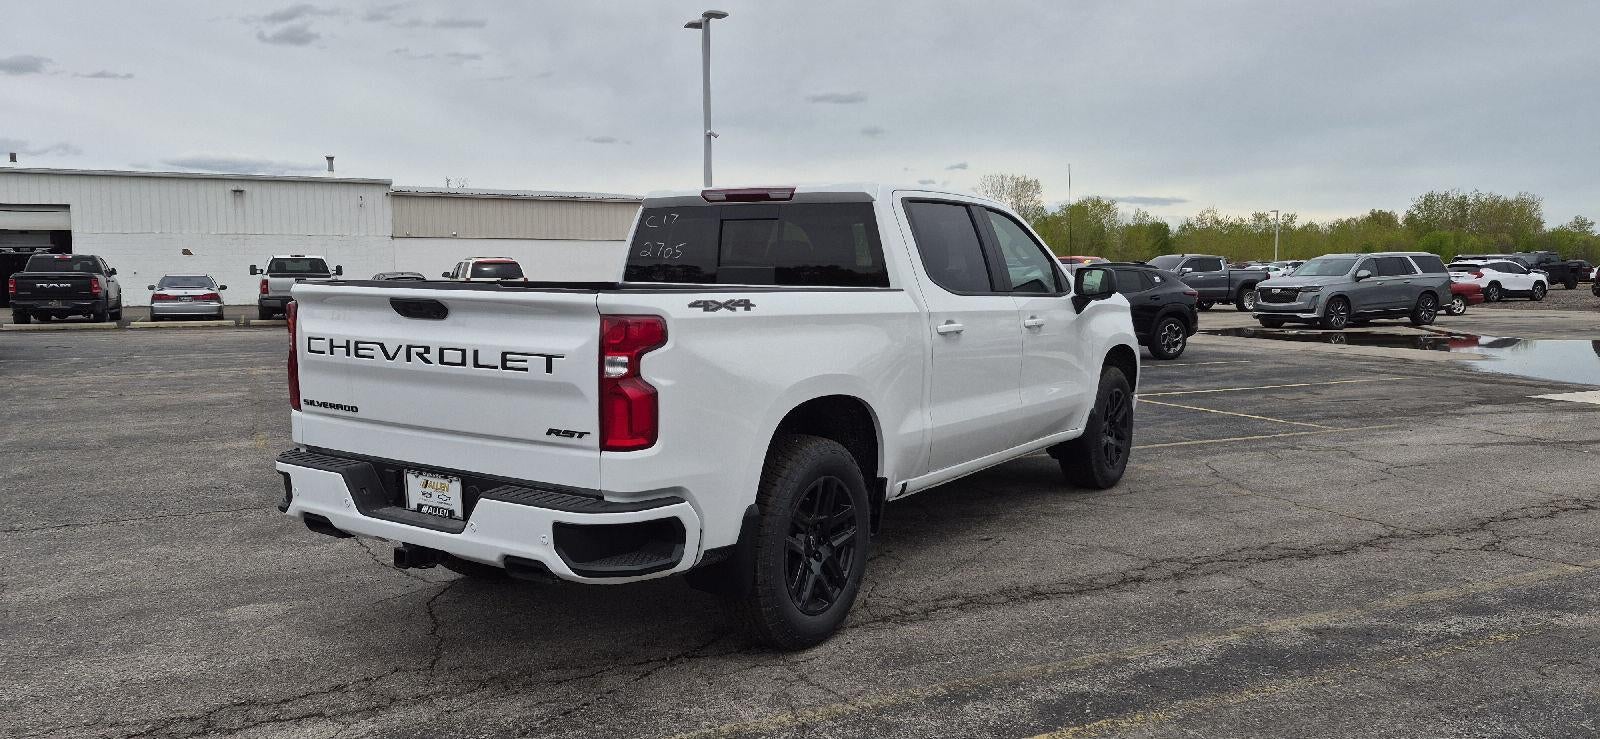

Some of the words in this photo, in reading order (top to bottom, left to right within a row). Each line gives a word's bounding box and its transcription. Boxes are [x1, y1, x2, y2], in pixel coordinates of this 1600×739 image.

[640, 242, 686, 259] 2705
[307, 336, 565, 374] CHEVROLET
[303, 398, 358, 413] SILVERADO
[545, 428, 591, 439] RST
[427, 480, 450, 492] ALLEN
[427, 505, 449, 516] ALLEN
